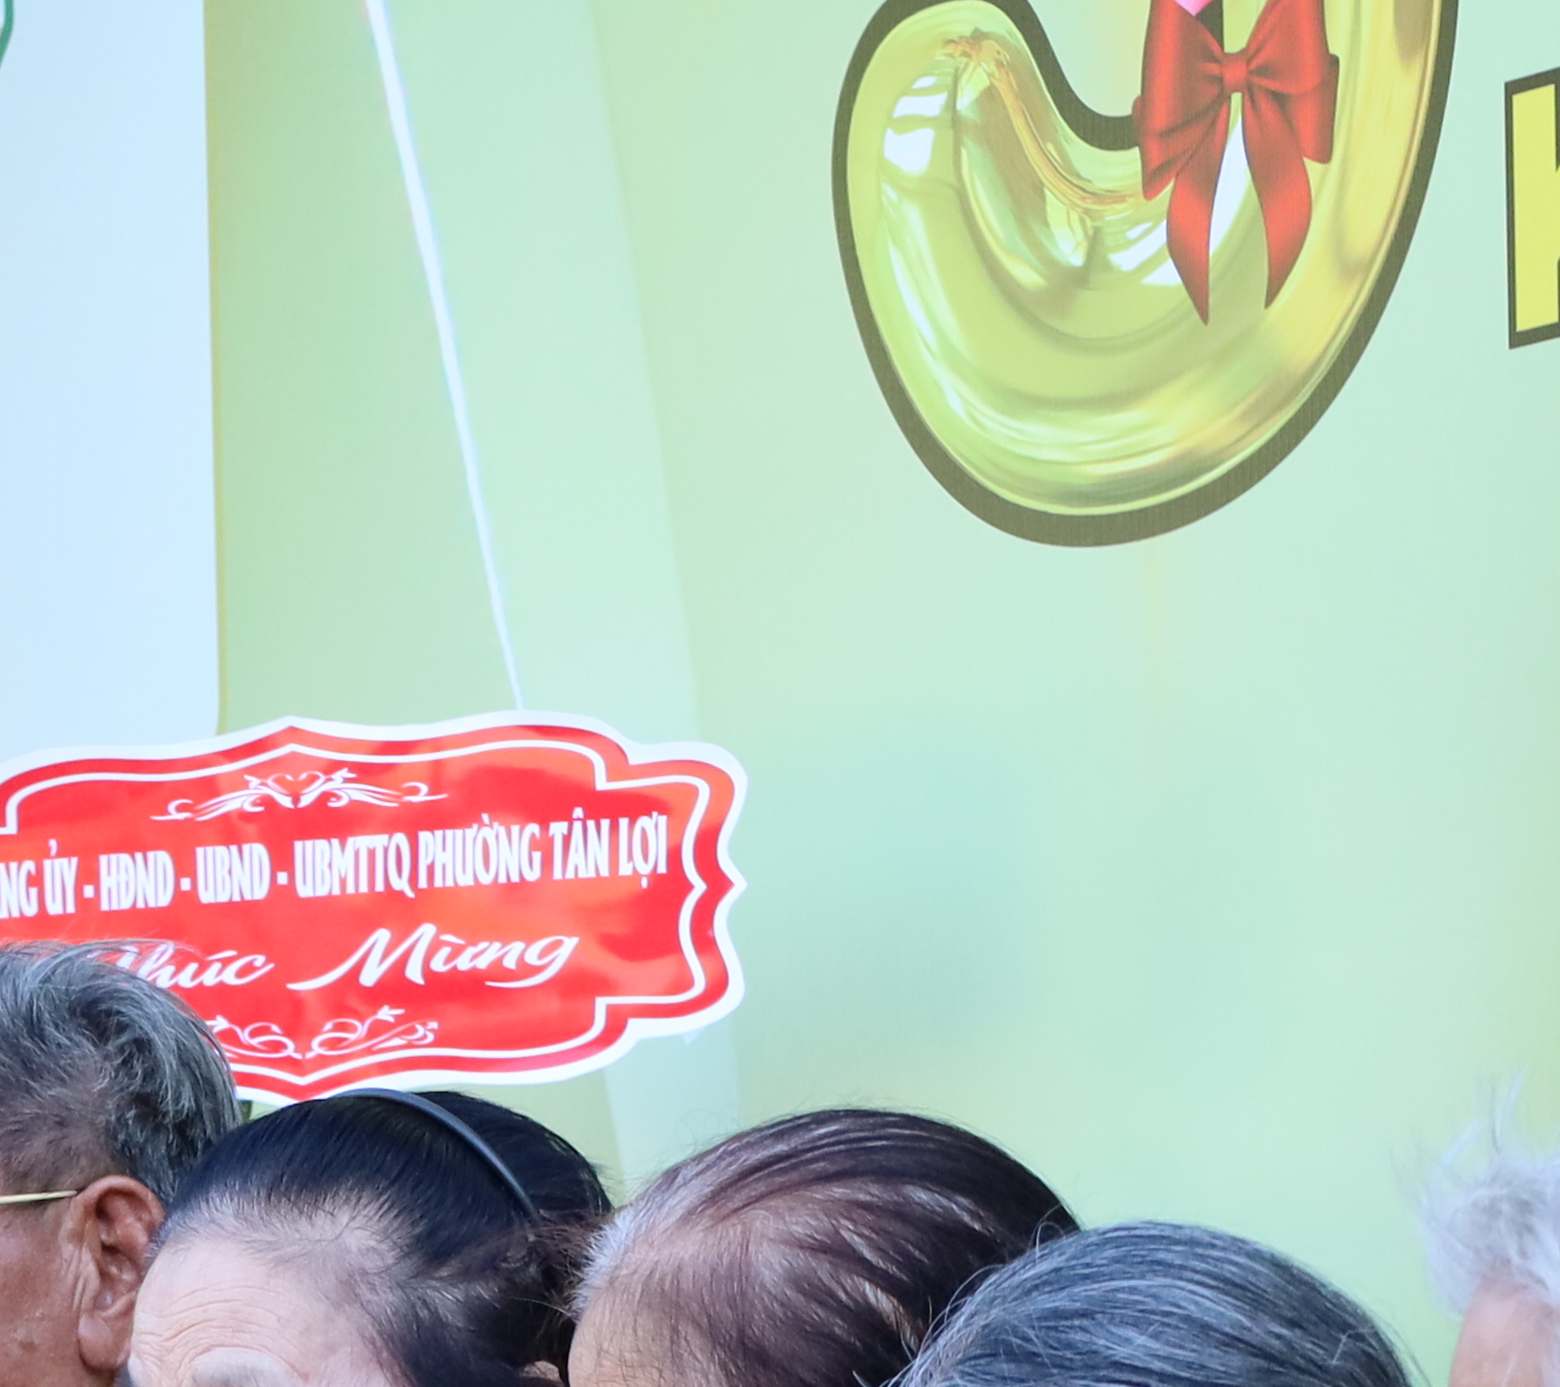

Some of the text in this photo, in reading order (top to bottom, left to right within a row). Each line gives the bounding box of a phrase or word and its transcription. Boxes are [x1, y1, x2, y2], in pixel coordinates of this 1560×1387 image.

[43, 838, 79, 916] ỦY
[98, 850, 175, 912] HĐND
[195, 842, 271, 904] UBND
[293, 832, 416, 899] UBMTTQ
[417, 812, 542, 889] PHƯỜNG
[548, 807, 611, 881] TÂN
[618, 811, 669, 889] LỢI
[285, 922, 580, 990] Mừng
